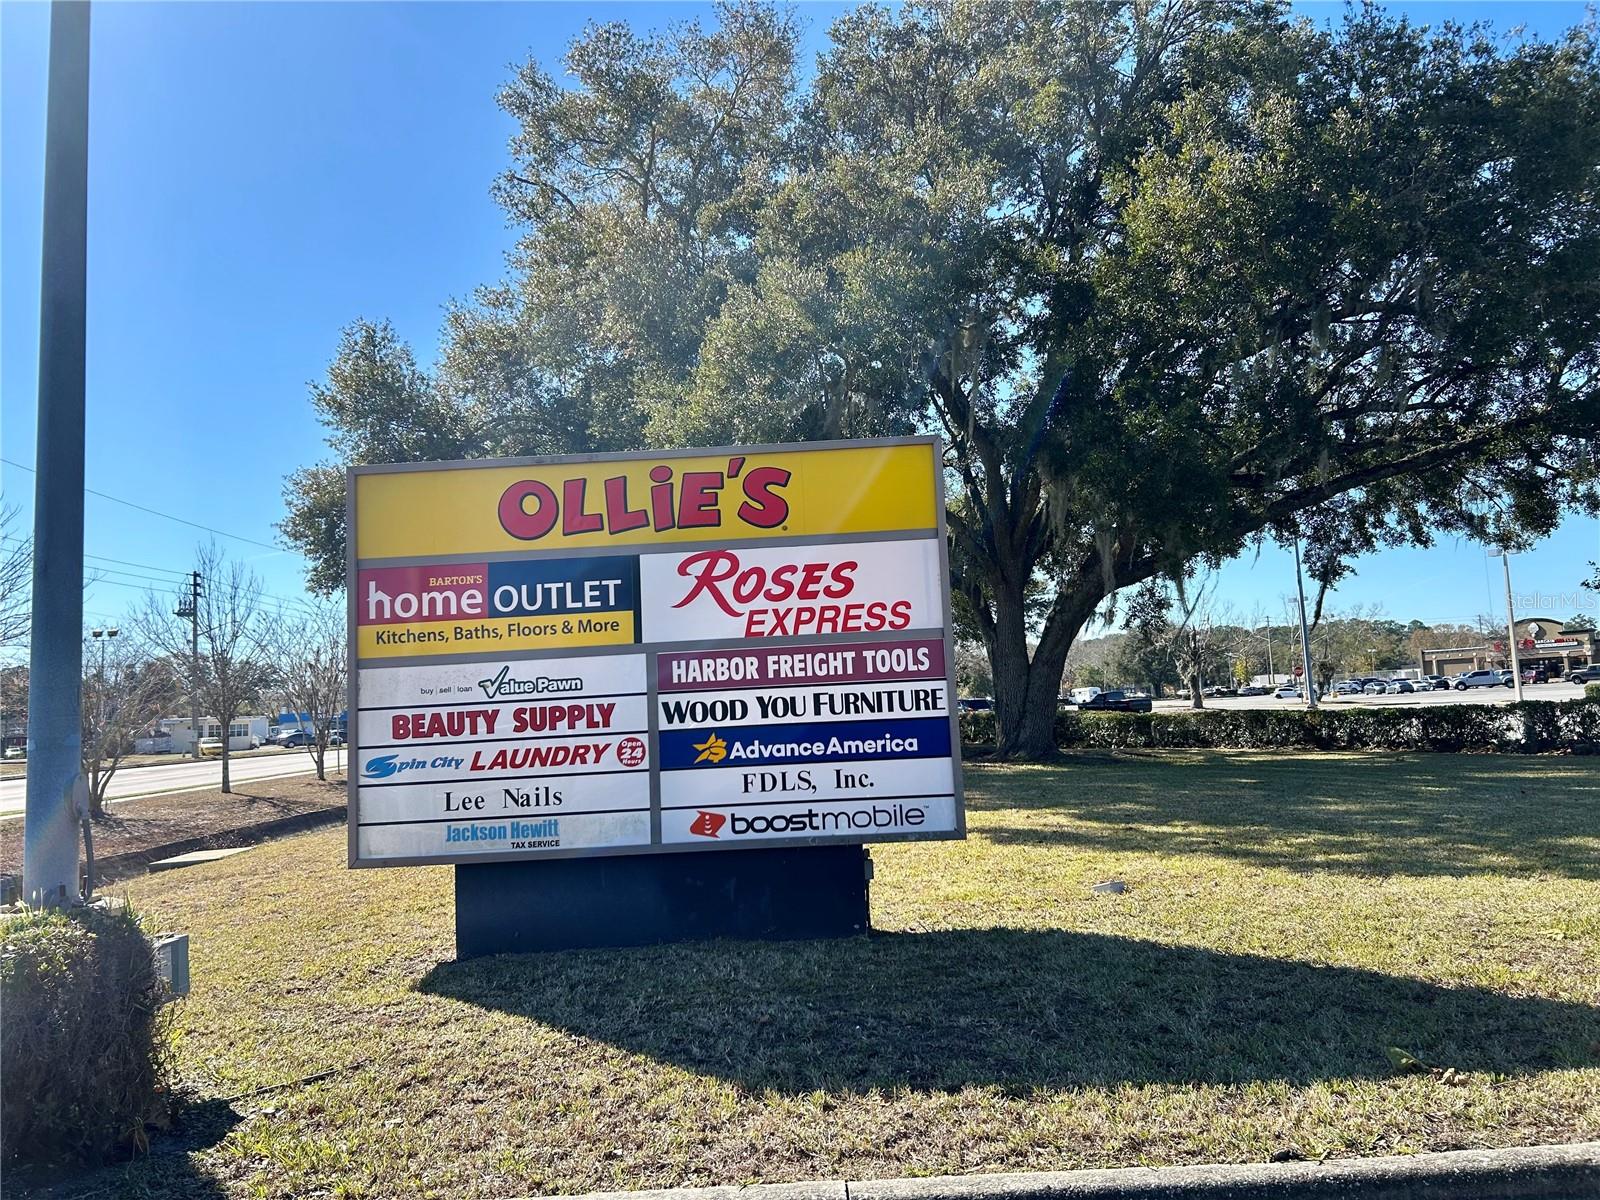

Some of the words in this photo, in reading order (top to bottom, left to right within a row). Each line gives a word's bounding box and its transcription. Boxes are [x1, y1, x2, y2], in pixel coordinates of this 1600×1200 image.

[429, 575, 483, 587] BARTON'S
[671, 549, 858, 617] ROSES
[367, 580, 482, 620] home
[493, 579, 622, 612] OUTLET
[376, 626, 449, 645] Kitchens,
[454, 624, 503, 641] Baths,
[507, 621, 557, 638] Floors
[562, 620, 574, 634] &
[577, 618, 620, 634] More
[744, 600, 912, 638] EXPRESS
[672, 656, 759, 684] HARBOR
[767, 651, 855, 679] FREIGHT
[863, 647, 930, 673] TOOLS
[420, 687, 434, 696] buy
[439, 686, 452, 694] sell
[457, 685, 473, 693] loan
[478, 665, 535, 698] Value
[536, 676, 583, 693] Pawn
[661, 698, 748, 724] WOOD
[755, 694, 806, 719] YOU
[813, 688, 946, 716] FURNITURE
[391, 709, 500, 740] BEAUTY
[512, 703, 616, 733] SUPPLY
[620, 747, 643, 759] 24
[621, 740, 642, 748] Open
[361, 754, 427, 779] Spin
[430, 756, 465, 771] City
[470, 742, 612, 771] LAUNDRY
[742, 770, 818, 794] FDLS,
[834, 768, 875, 789] Inc.
[443, 791, 485, 812] Lee
[502, 786, 563, 809] Nails
[446, 823, 507, 842] Jackson
[510, 819, 560, 840] Hewitt
[510, 841, 526, 849] TAX
[527, 839, 560, 849] SERVICE
